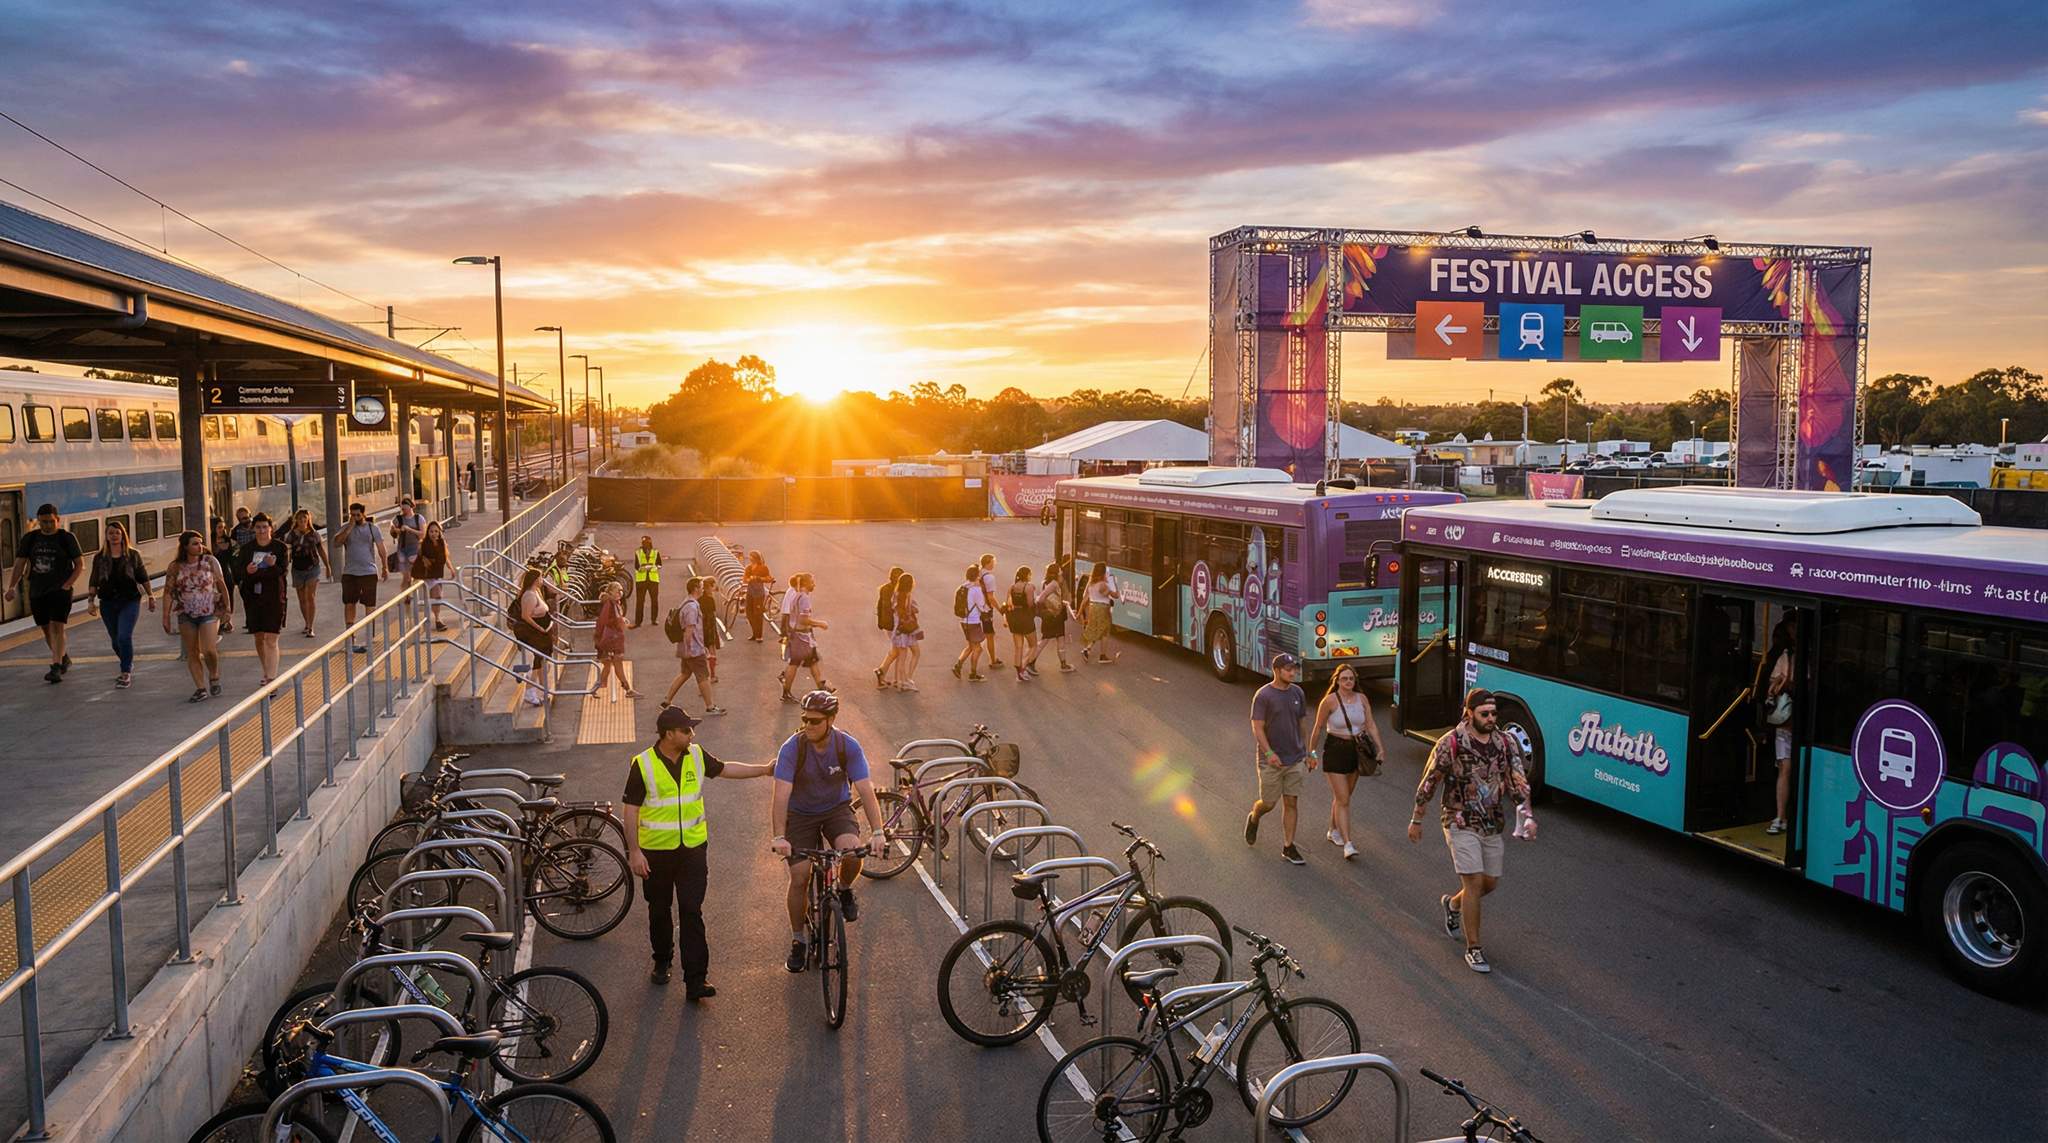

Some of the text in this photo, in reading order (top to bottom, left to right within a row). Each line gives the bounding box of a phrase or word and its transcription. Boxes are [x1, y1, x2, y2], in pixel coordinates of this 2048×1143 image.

[1430, 257, 1713, 298] FESTIVAL ACCESS
[211, 387, 222, 403] 2
